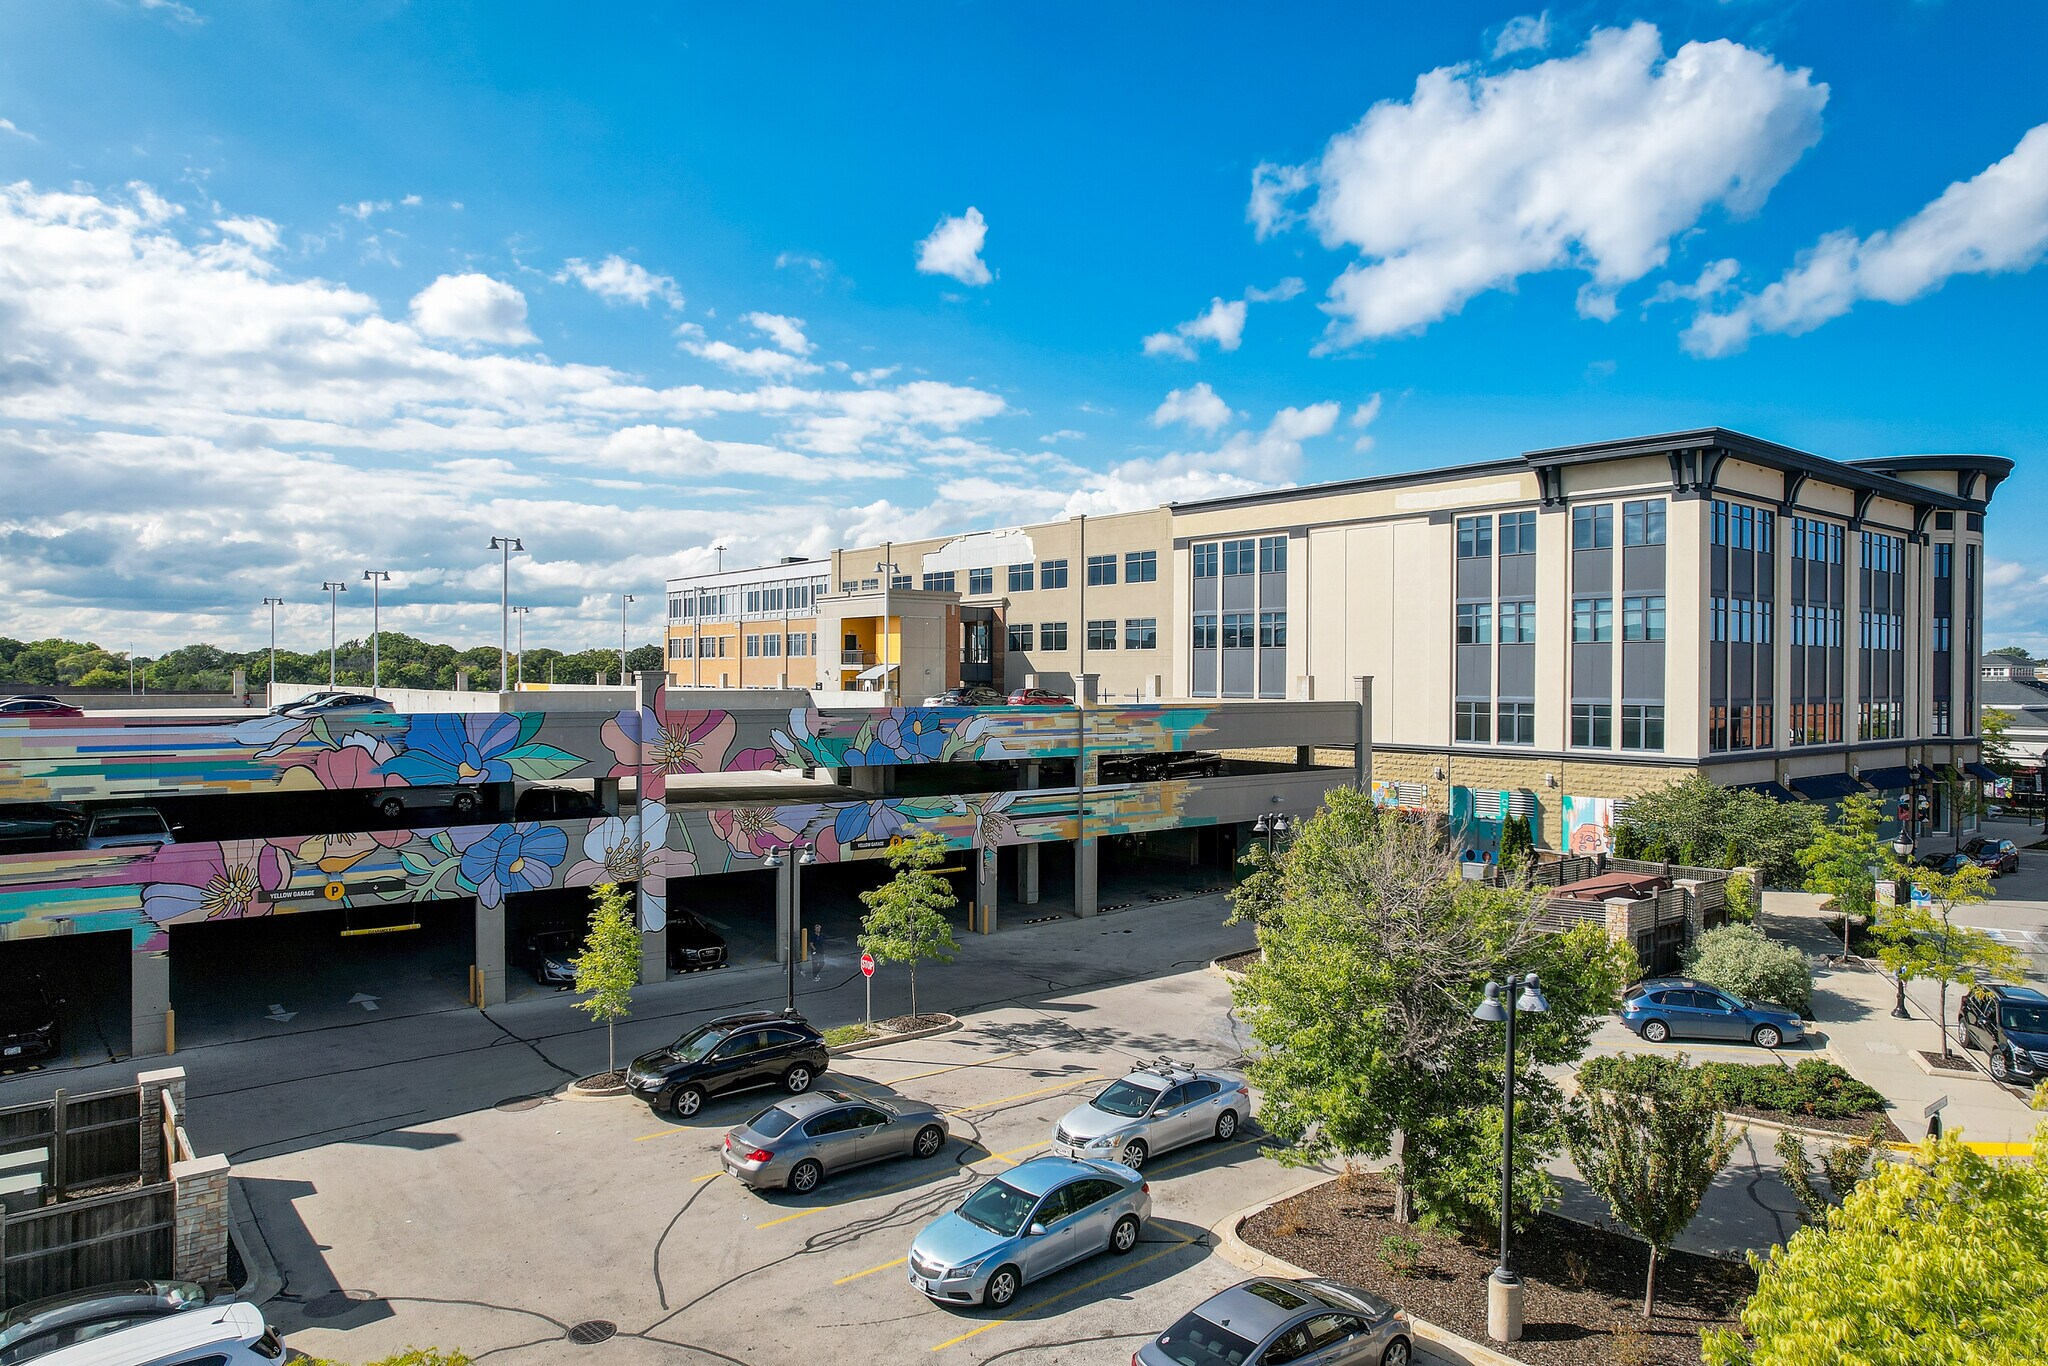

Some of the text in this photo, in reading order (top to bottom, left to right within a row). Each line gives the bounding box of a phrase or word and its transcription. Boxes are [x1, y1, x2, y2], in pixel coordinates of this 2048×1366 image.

[269, 891, 293, 899] YELLOW
[331, 886, 339, 896] P
[861, 959, 874, 970] STOP
